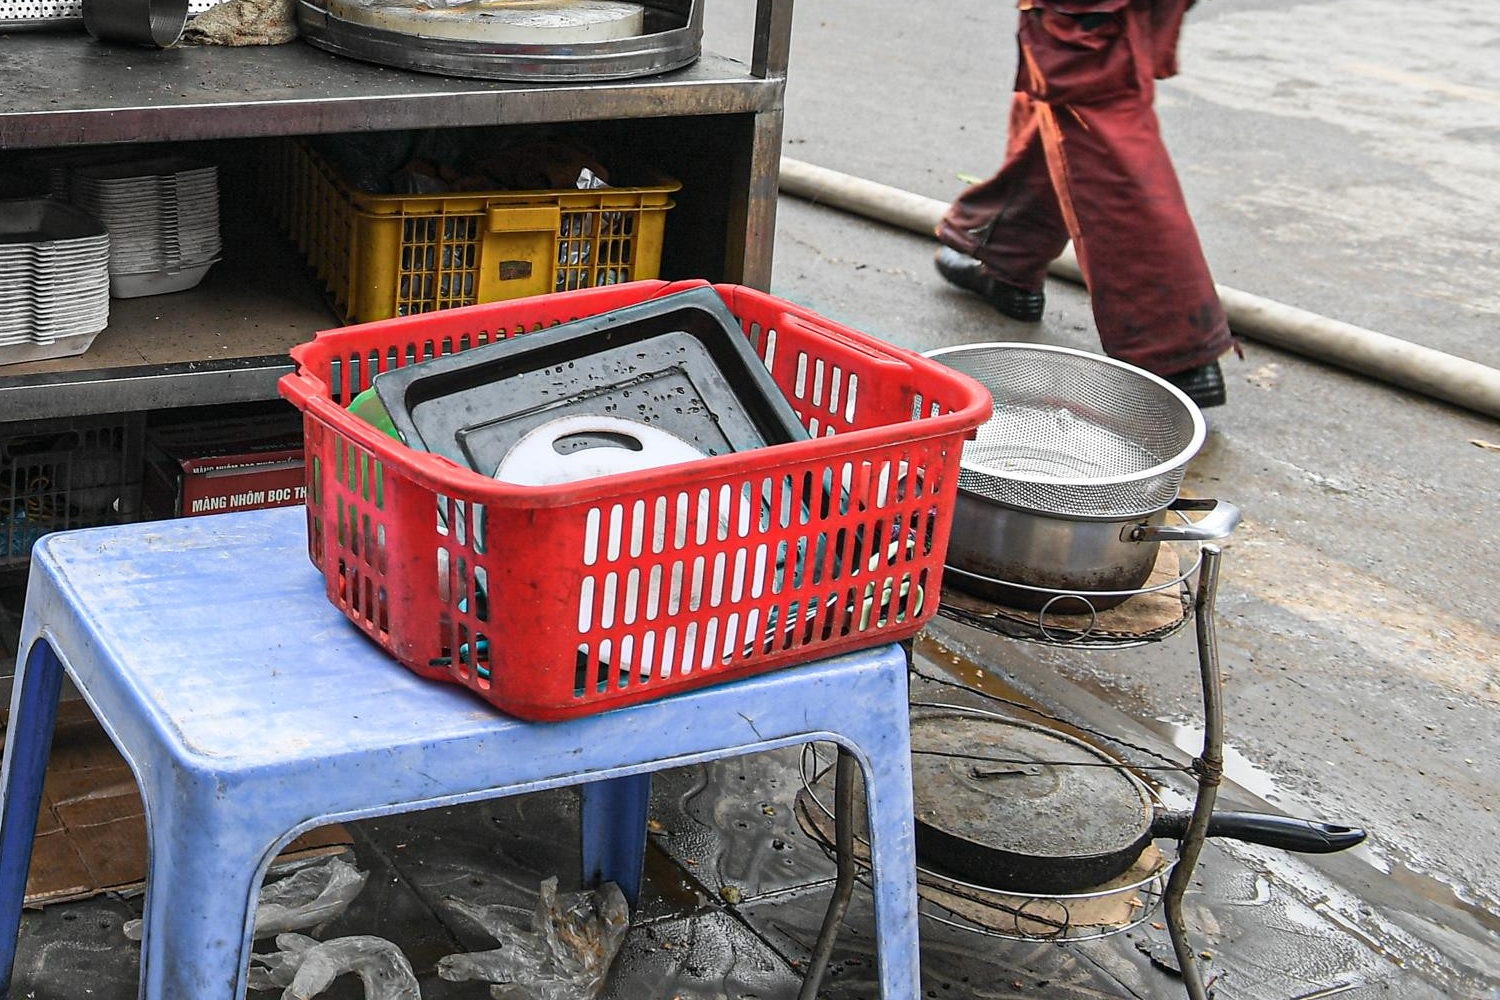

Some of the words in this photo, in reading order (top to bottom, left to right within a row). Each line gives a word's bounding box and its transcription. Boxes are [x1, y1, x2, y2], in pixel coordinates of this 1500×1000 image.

[192, 496, 227, 513] MÀNG
[230, 490, 265, 507] NHÔM
[268, 489, 291, 504] BỌC
[294, 486, 307, 499] TH
